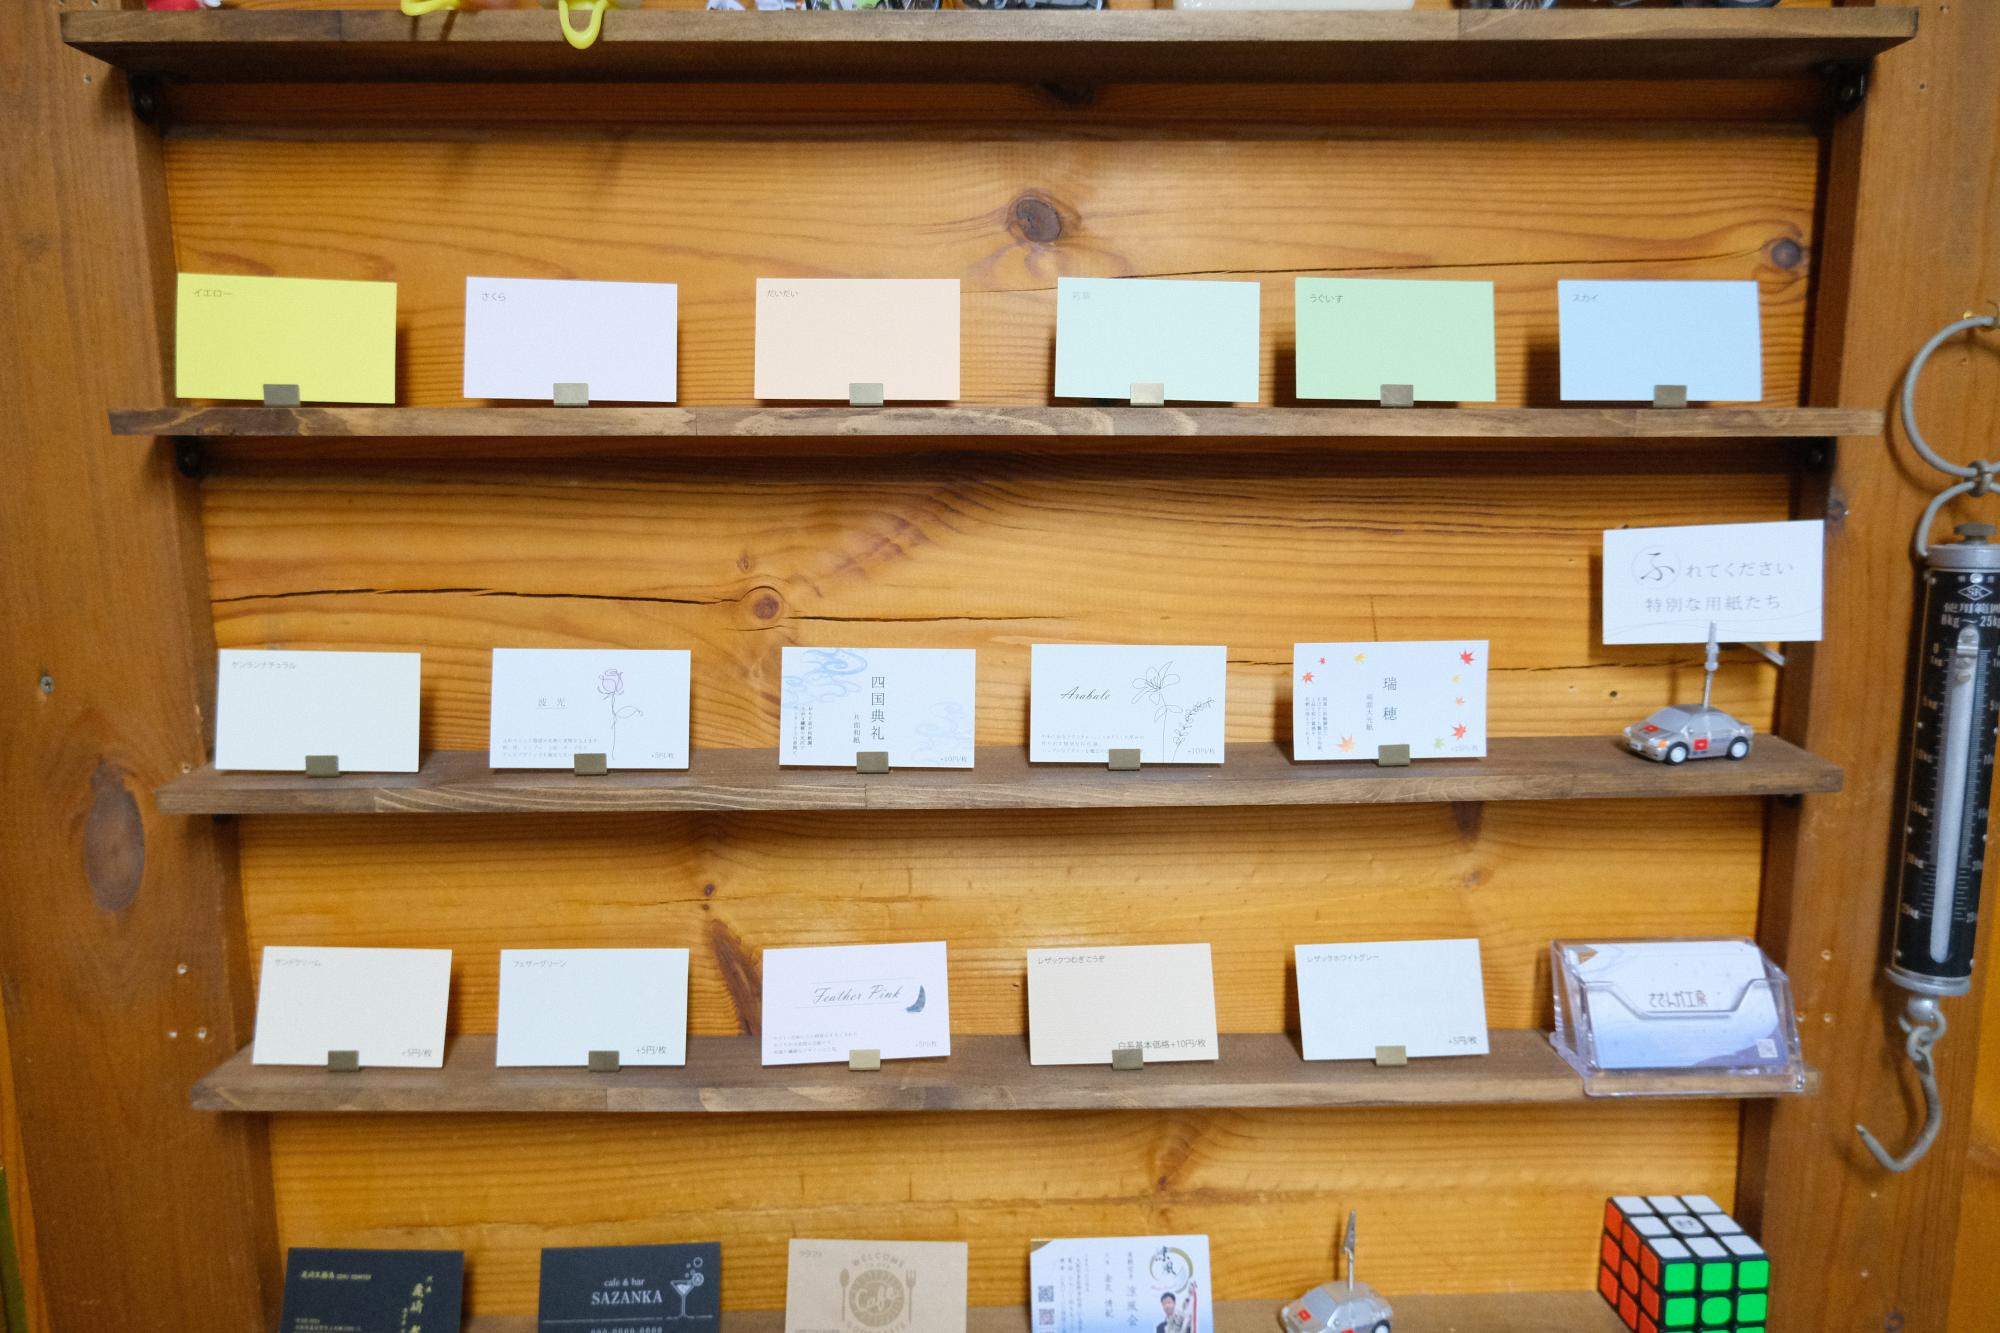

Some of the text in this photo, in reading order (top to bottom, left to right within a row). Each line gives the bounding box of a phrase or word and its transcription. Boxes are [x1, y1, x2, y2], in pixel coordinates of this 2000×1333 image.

[193, 287, 233, 298] イエロー
[480, 291, 506, 302] さくら
[1310, 293, 1343, 304] うぐいす
[1646, 594, 1781, 613] 特別な用紙たち
[1383, 676, 1398, 721] 瑞穂
[871, 676, 885, 741] 四国典礼
[812, 984, 903, 1004] Feather Pink
[631, 1277, 645, 1287] bar
[591, 1289, 663, 1305] SAZANKA
